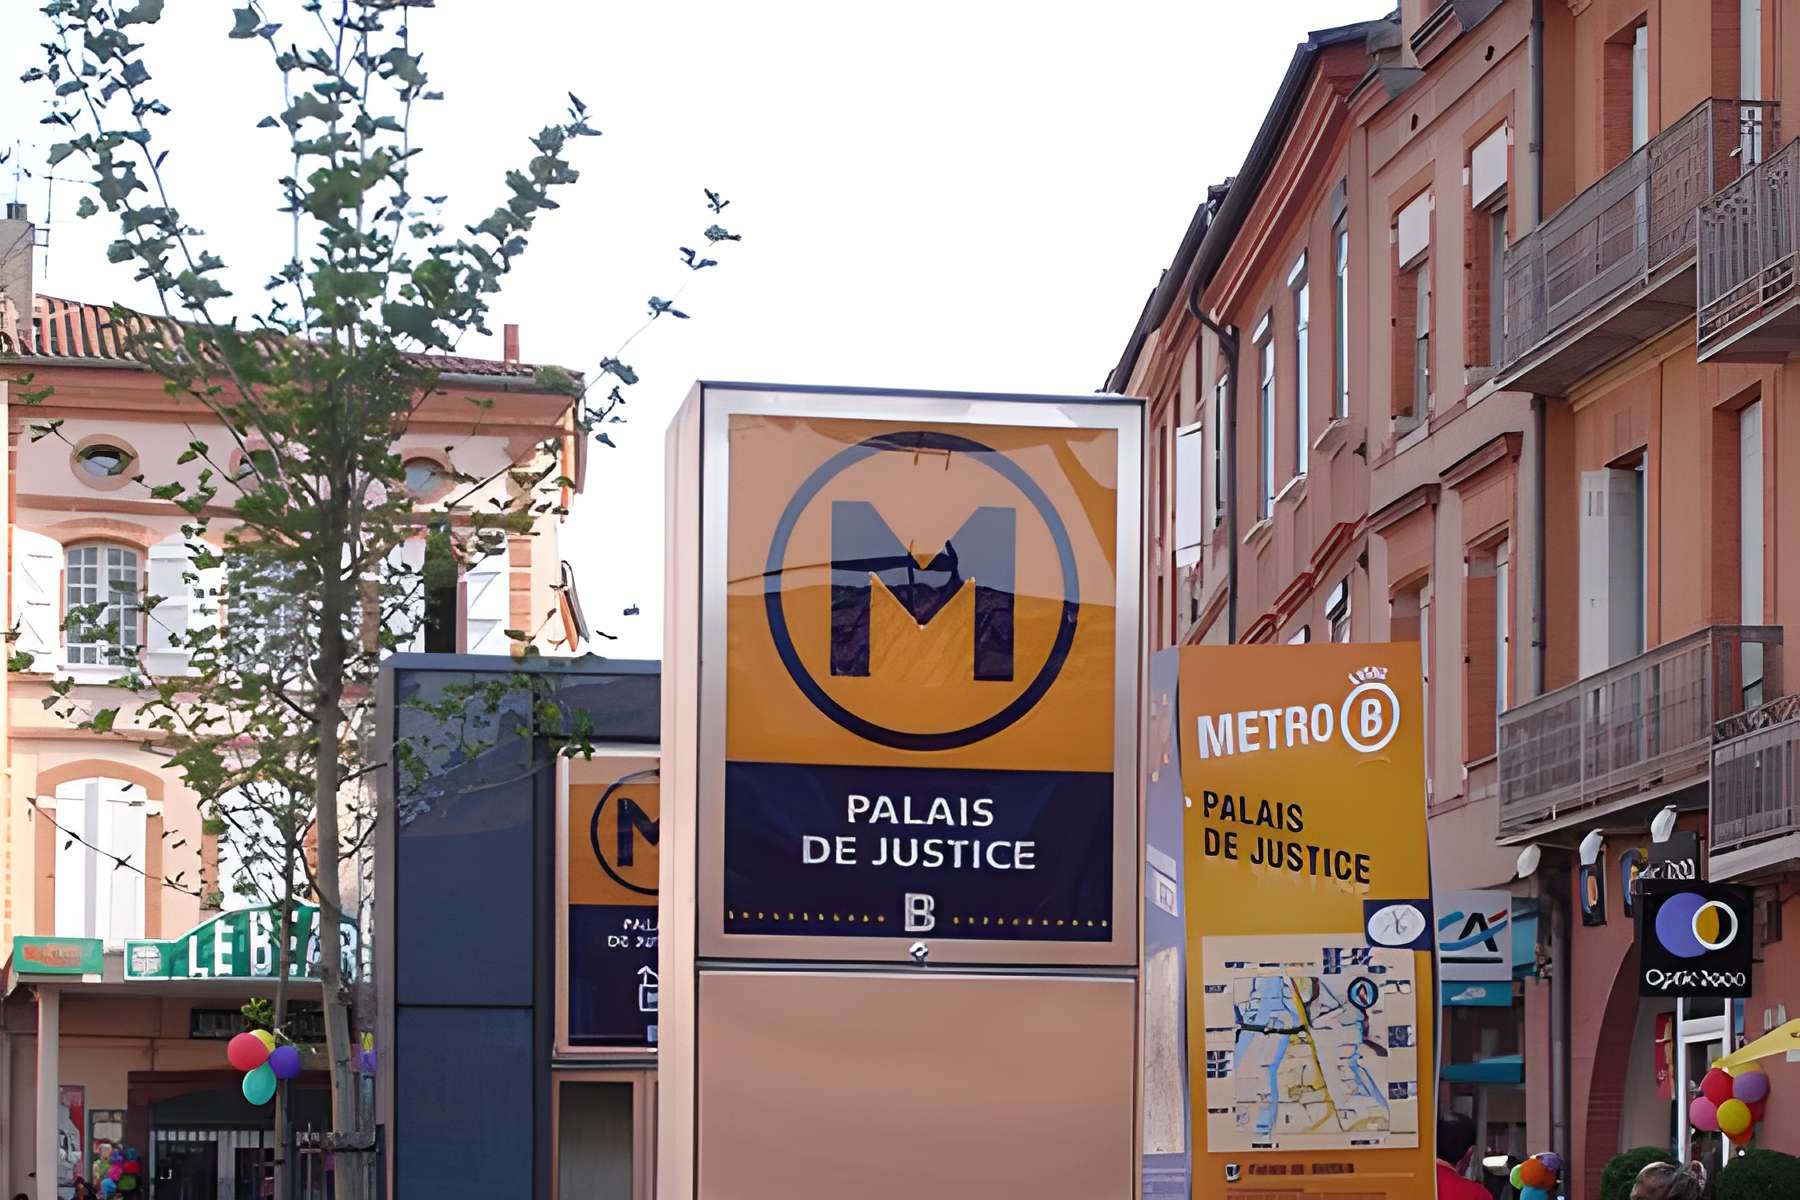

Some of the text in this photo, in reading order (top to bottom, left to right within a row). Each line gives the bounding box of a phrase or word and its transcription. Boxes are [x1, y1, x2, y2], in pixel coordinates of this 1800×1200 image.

[830, 501, 1016, 682] M
[1197, 698, 1383, 759] METRO B
[847, 794, 994, 827] PALAIS
[1203, 790, 1304, 833] PALAIS
[802, 835, 1035, 869] DE JUSTICE
[1204, 827, 1370, 884] DE JUSTICE
[905, 892, 935, 932] B
[188, 919, 234, 977] LE
